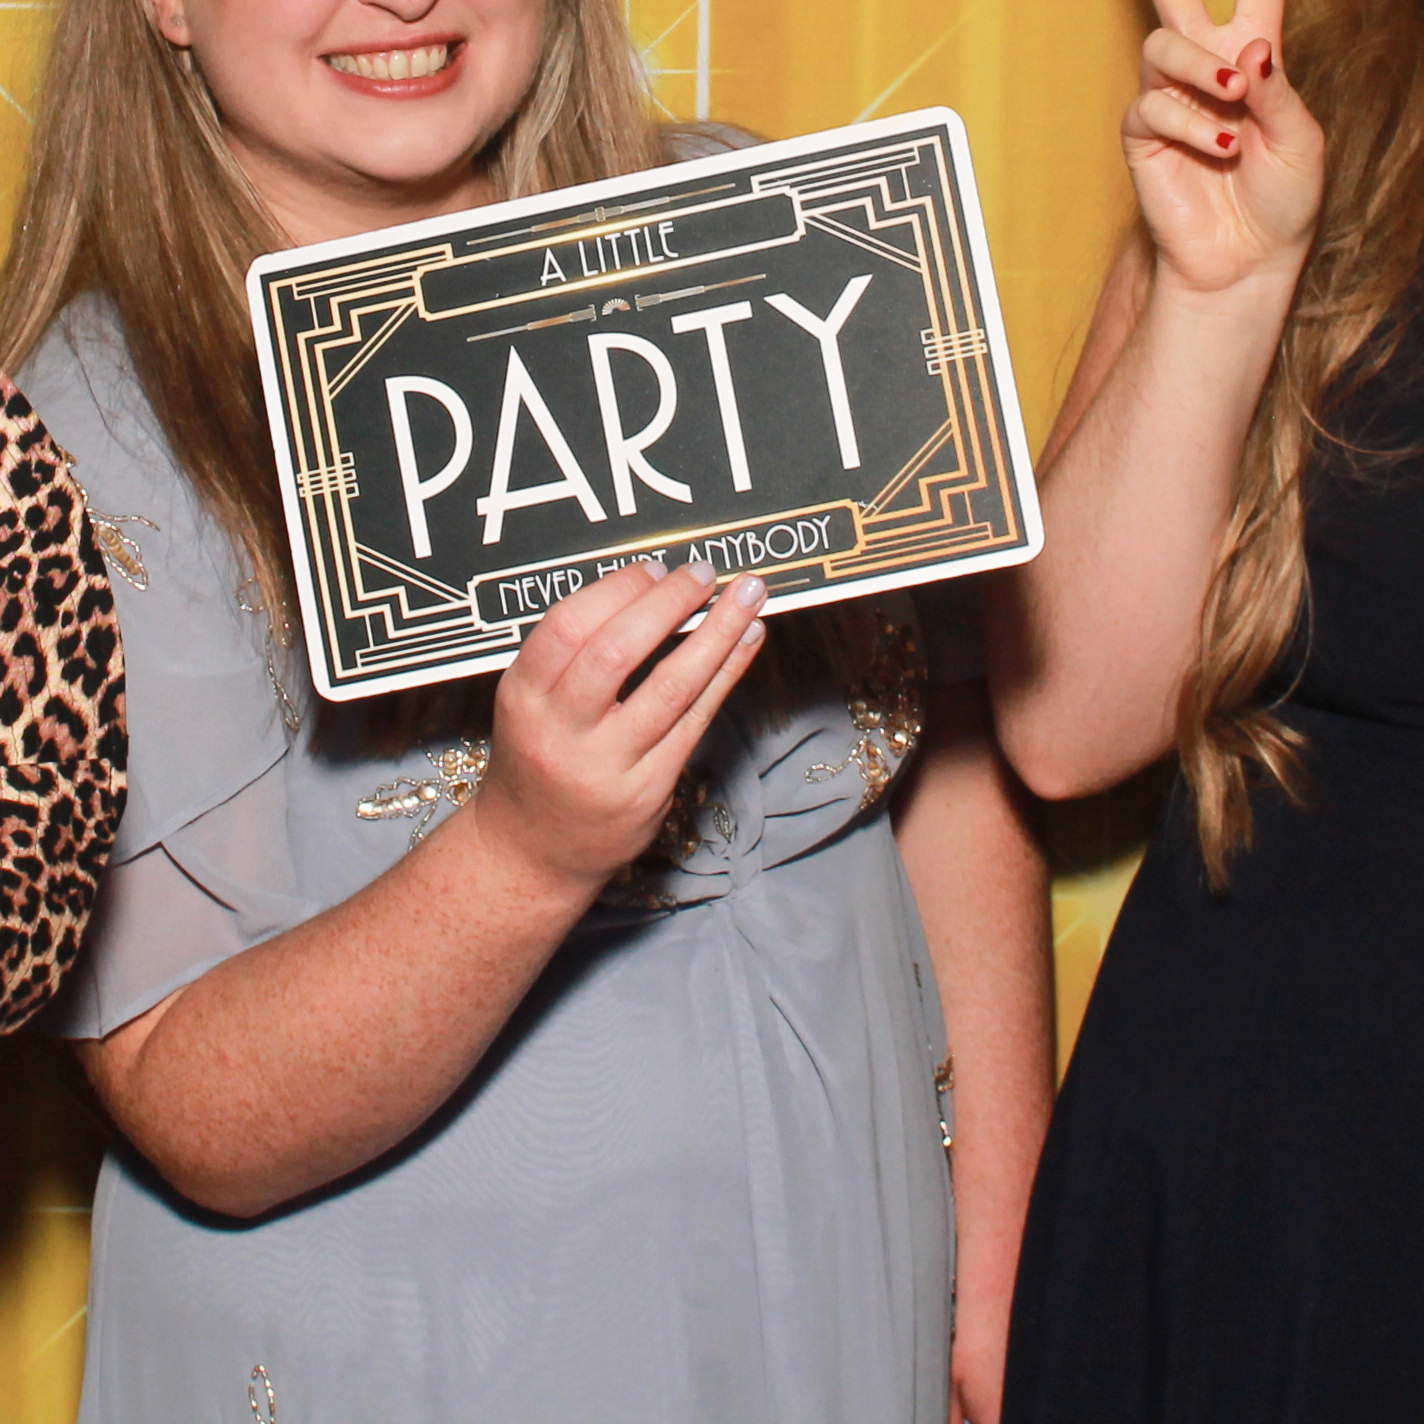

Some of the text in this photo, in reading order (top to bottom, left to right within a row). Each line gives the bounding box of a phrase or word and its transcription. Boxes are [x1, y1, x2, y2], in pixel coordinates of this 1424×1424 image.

[540, 221, 679, 286] A LITTLE
[384, 273, 873, 559] PARTY
